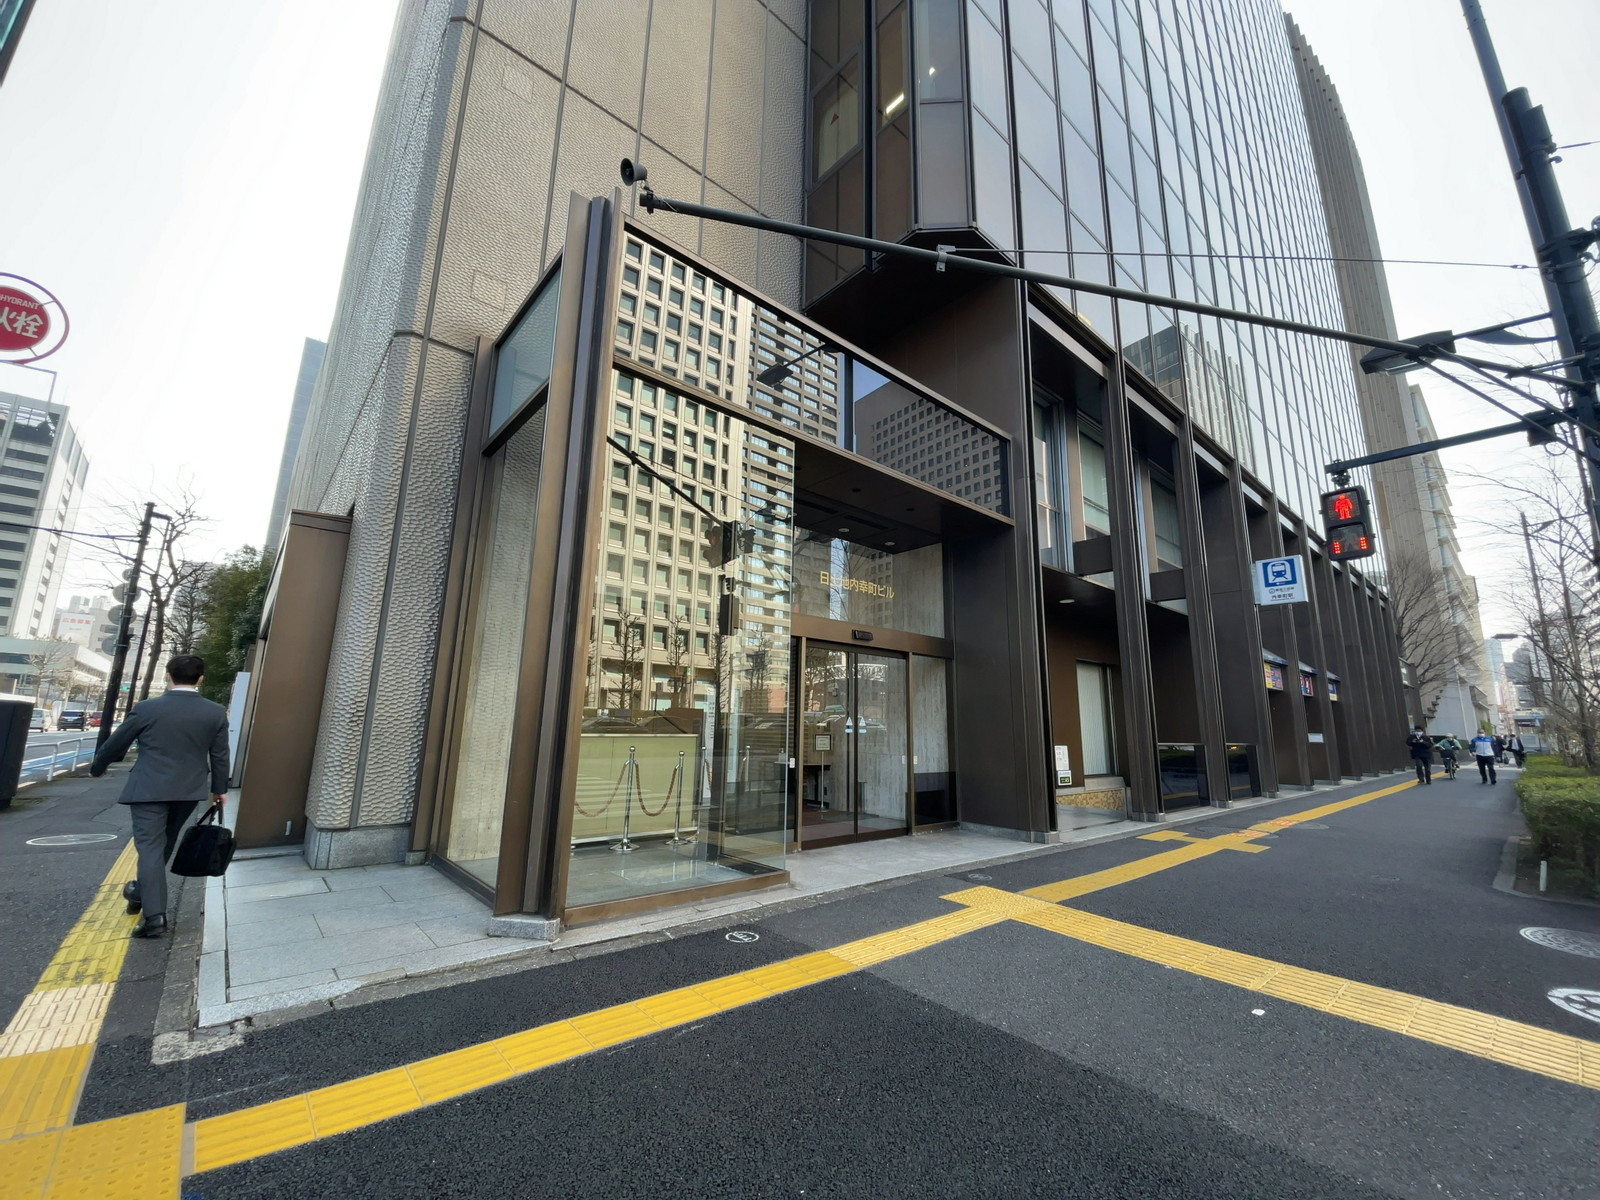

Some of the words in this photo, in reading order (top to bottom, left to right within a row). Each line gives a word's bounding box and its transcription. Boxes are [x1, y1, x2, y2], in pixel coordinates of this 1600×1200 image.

[0, 294, 39, 309] HYDRANT
[820, 571, 895, 599] 日土地内幸町ビル
